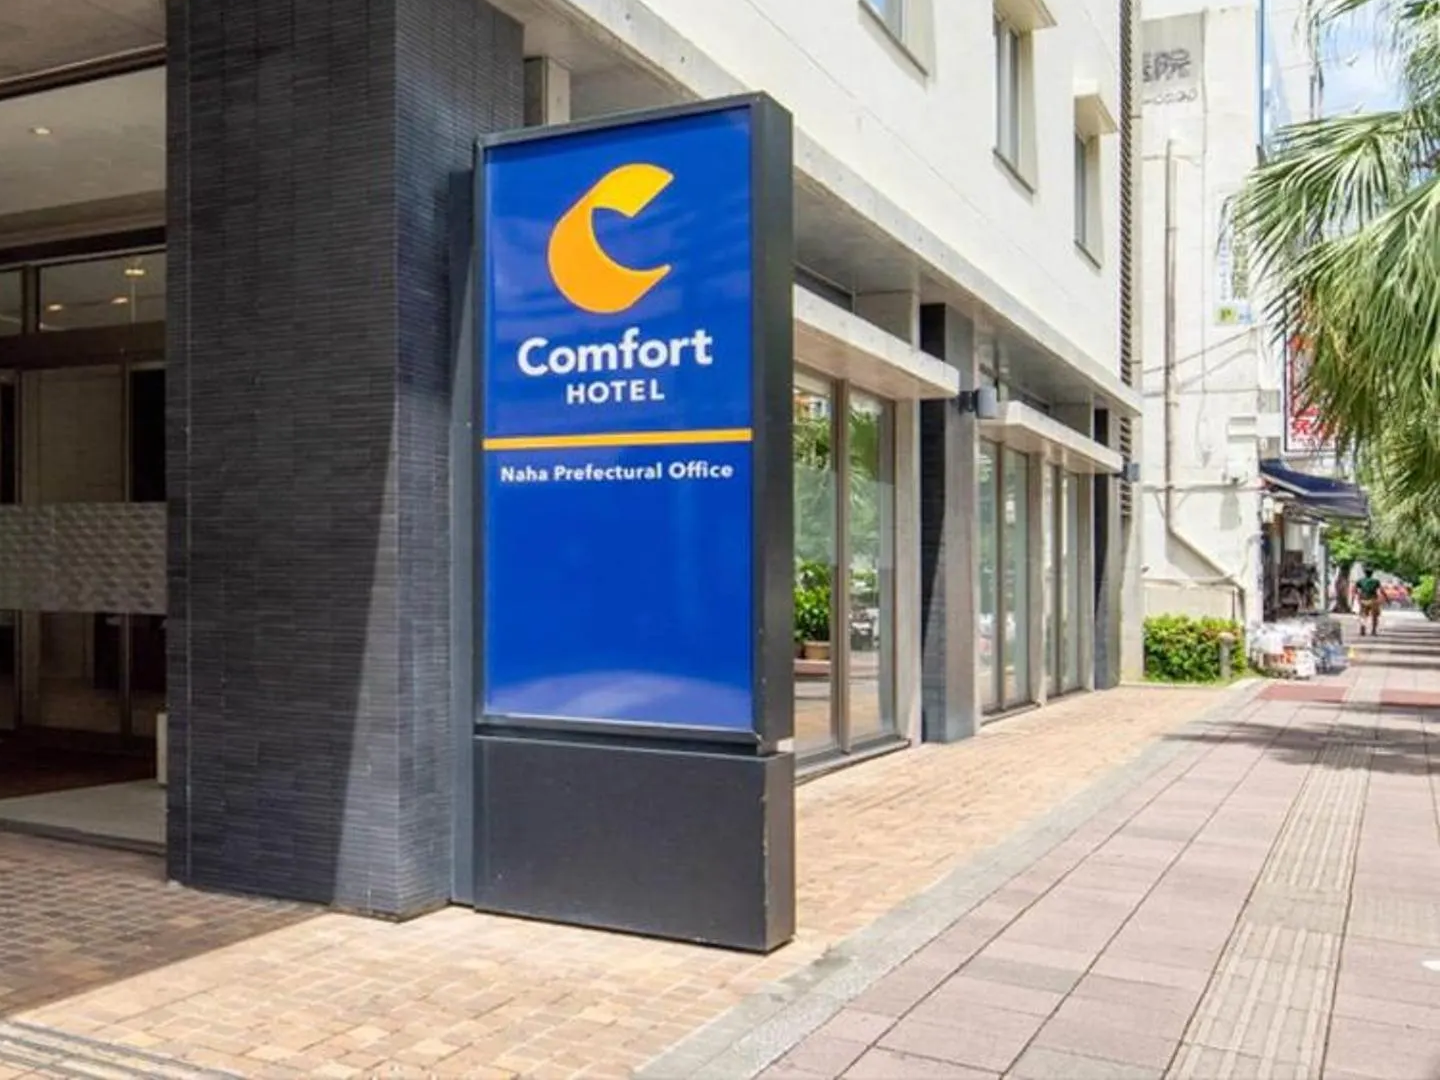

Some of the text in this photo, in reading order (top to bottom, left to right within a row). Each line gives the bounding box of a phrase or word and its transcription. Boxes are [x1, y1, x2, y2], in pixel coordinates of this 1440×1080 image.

[517, 327, 713, 376] Comfort
[566, 379, 665, 405] HOTEL
[500, 460, 733, 482] Naha Prefectural Office
